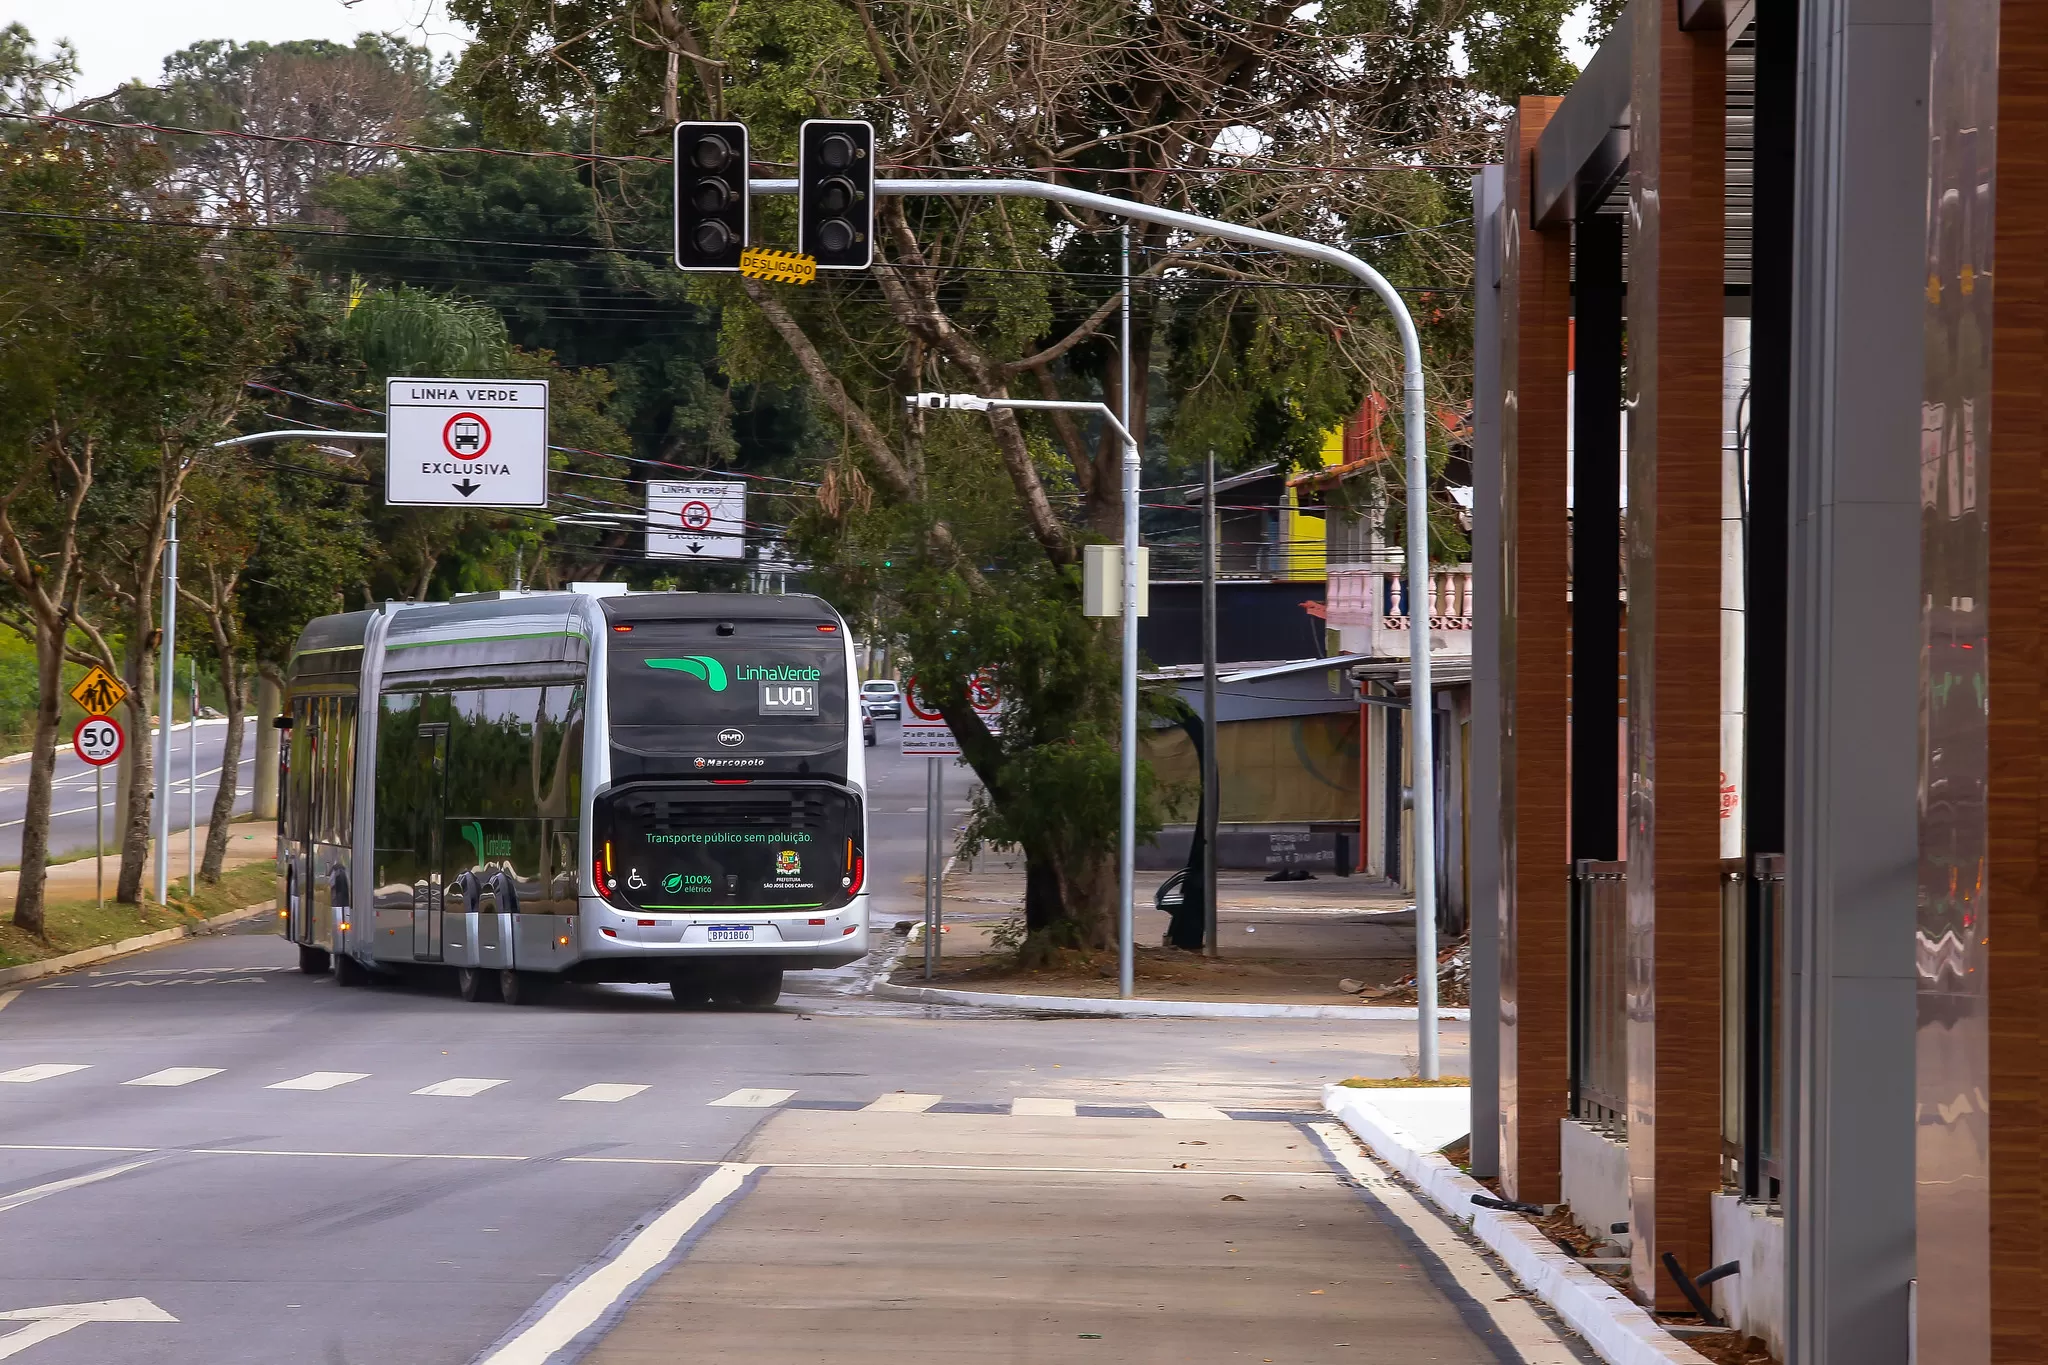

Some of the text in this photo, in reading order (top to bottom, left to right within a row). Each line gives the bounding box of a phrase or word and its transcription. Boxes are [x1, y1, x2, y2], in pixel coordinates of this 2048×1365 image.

[743, 257, 812, 275] DESLIGADO
[411, 388, 518, 401] LINHA VERDE
[422, 463, 511, 475] EXCLUSIVA
[661, 486, 729, 494] LINHA VERDE
[736, 665, 821, 681] LinhaVerde
[765, 687, 813, 706] LV01
[83, 727, 115, 748] 50
[720, 733, 742, 741] BYD
[707, 759, 764, 767] Marcopolo
[645, 832, 813, 845] Transporte público sem poluição.
[684, 875, 712, 884] 100%
[684, 885, 712, 893] elétrico
[88, 966, 300, 977] VERD
